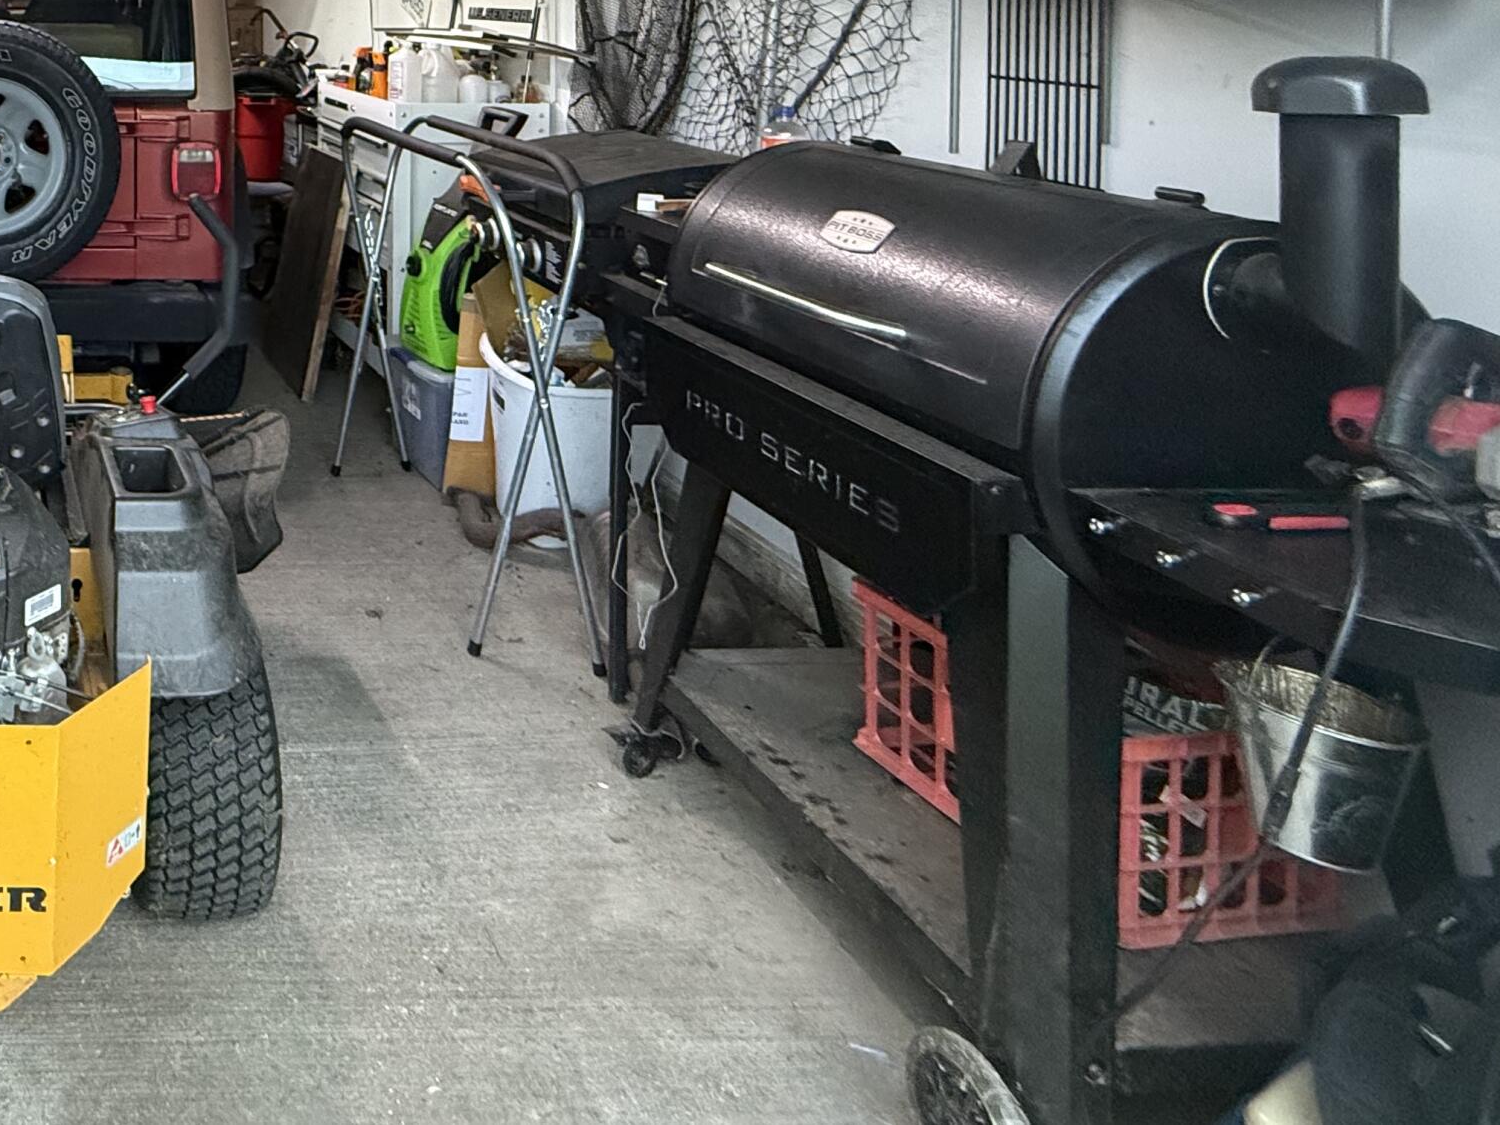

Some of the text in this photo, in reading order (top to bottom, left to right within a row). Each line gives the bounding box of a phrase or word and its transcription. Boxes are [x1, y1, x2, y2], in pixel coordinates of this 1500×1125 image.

[11, 87, 98, 263] GOODYEAR
[847, 226, 885, 242] BOSS
[686, 389, 900, 534] PRO SERIES
